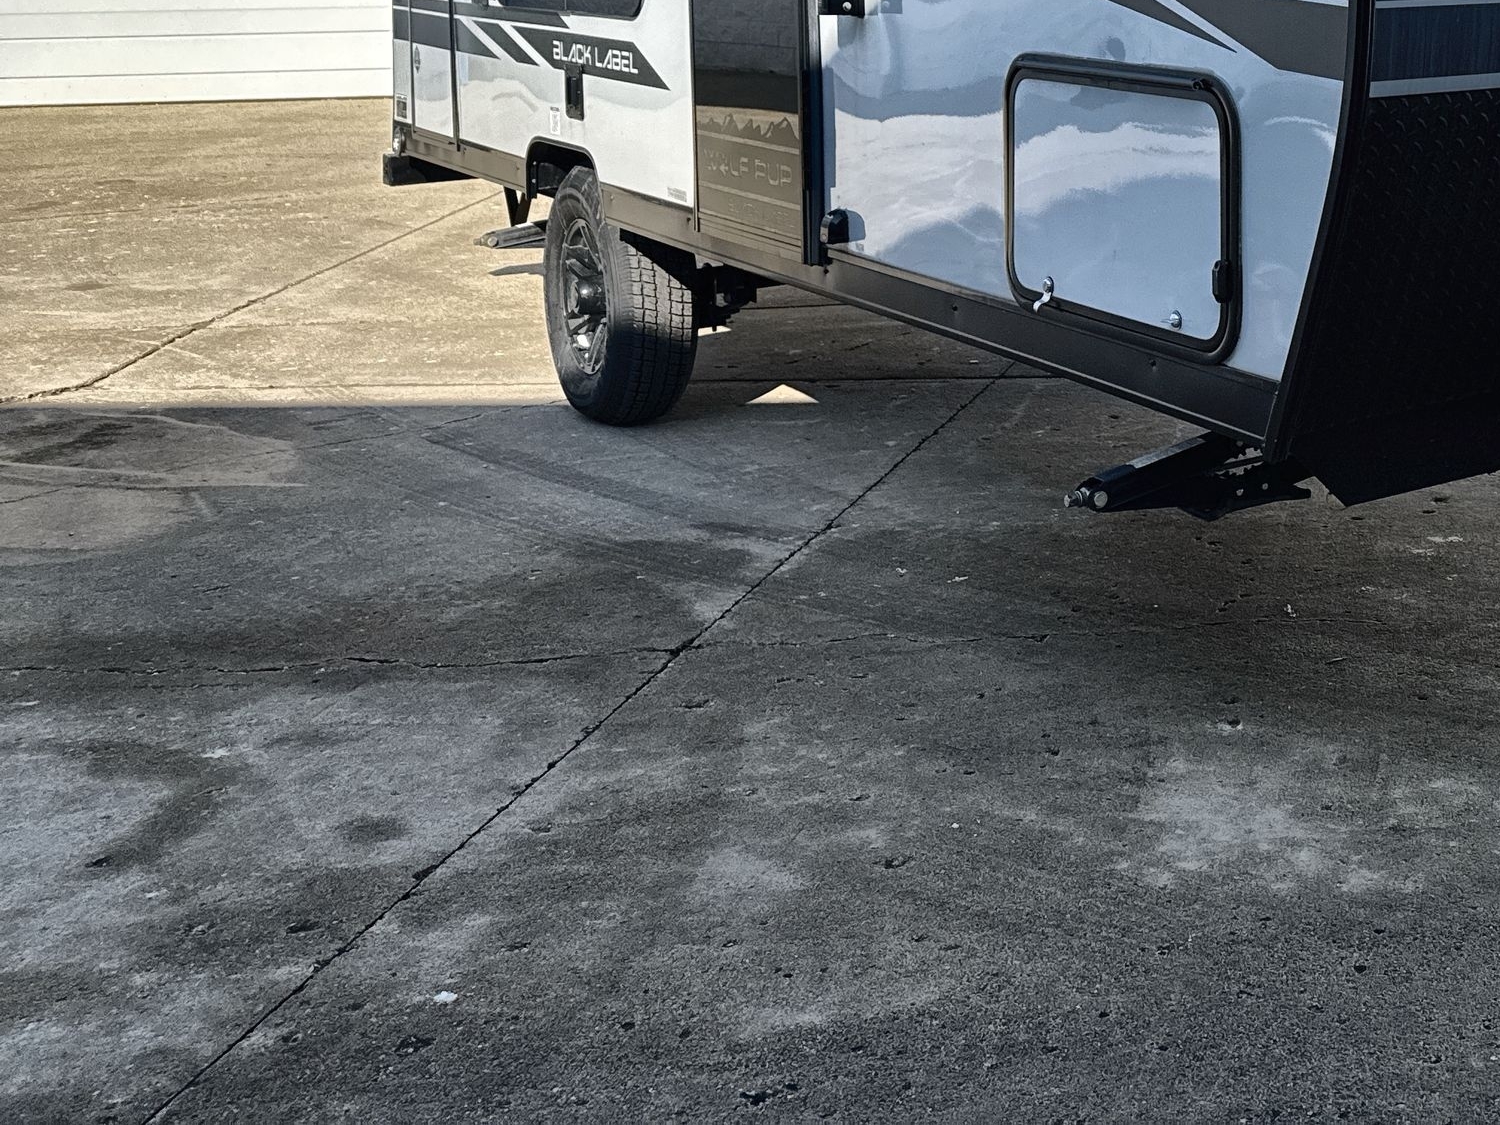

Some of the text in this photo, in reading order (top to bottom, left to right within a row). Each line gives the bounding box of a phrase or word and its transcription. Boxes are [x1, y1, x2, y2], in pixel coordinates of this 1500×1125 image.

[552, 40, 639, 74] BLACK LABEL
[754, 159, 793, 187] PUP
